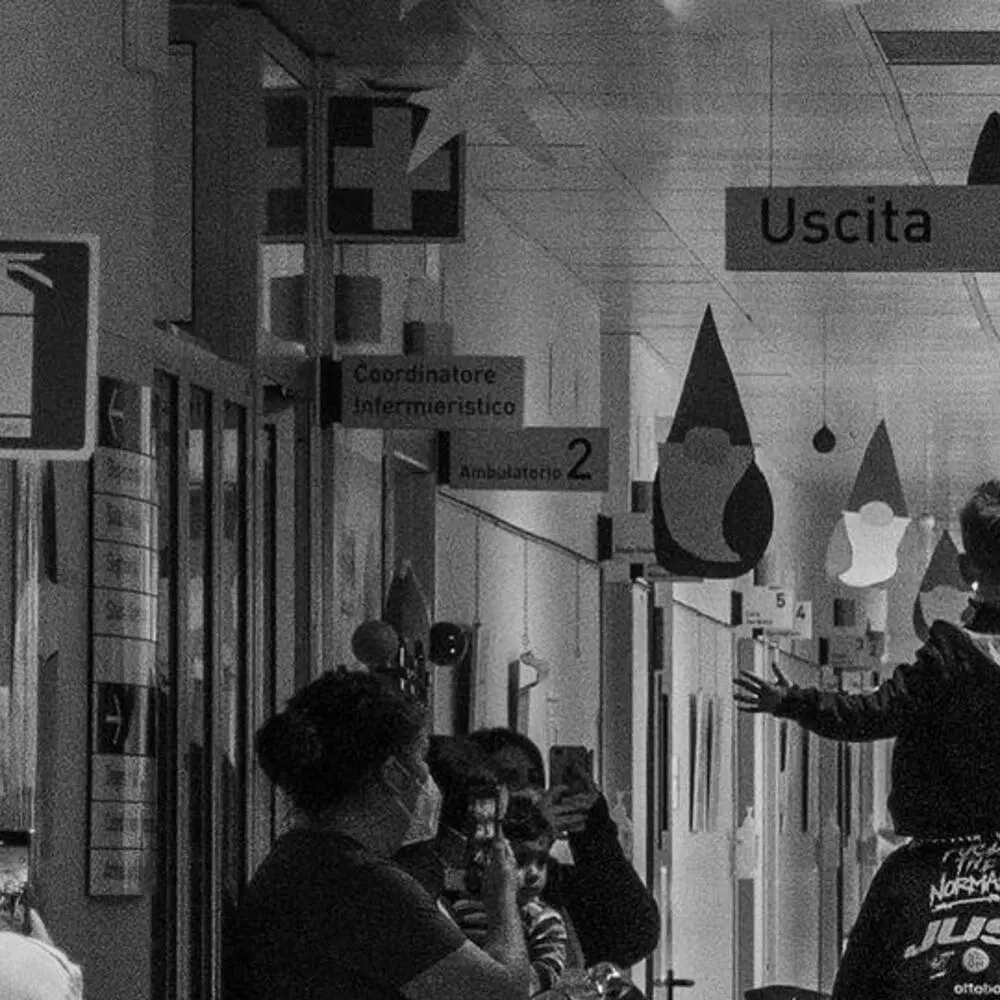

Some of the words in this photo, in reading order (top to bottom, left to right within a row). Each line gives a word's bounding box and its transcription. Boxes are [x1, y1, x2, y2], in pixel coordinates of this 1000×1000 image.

[761, 196, 932, 244] Uscita
[354, 364, 497, 385] Coordinatore
[354, 396, 517, 416] Infermieristico
[459, 464, 561, 481] Ambulatorio
[566, 438, 592, 480] 2
[776, 591, 786, 609] 5
